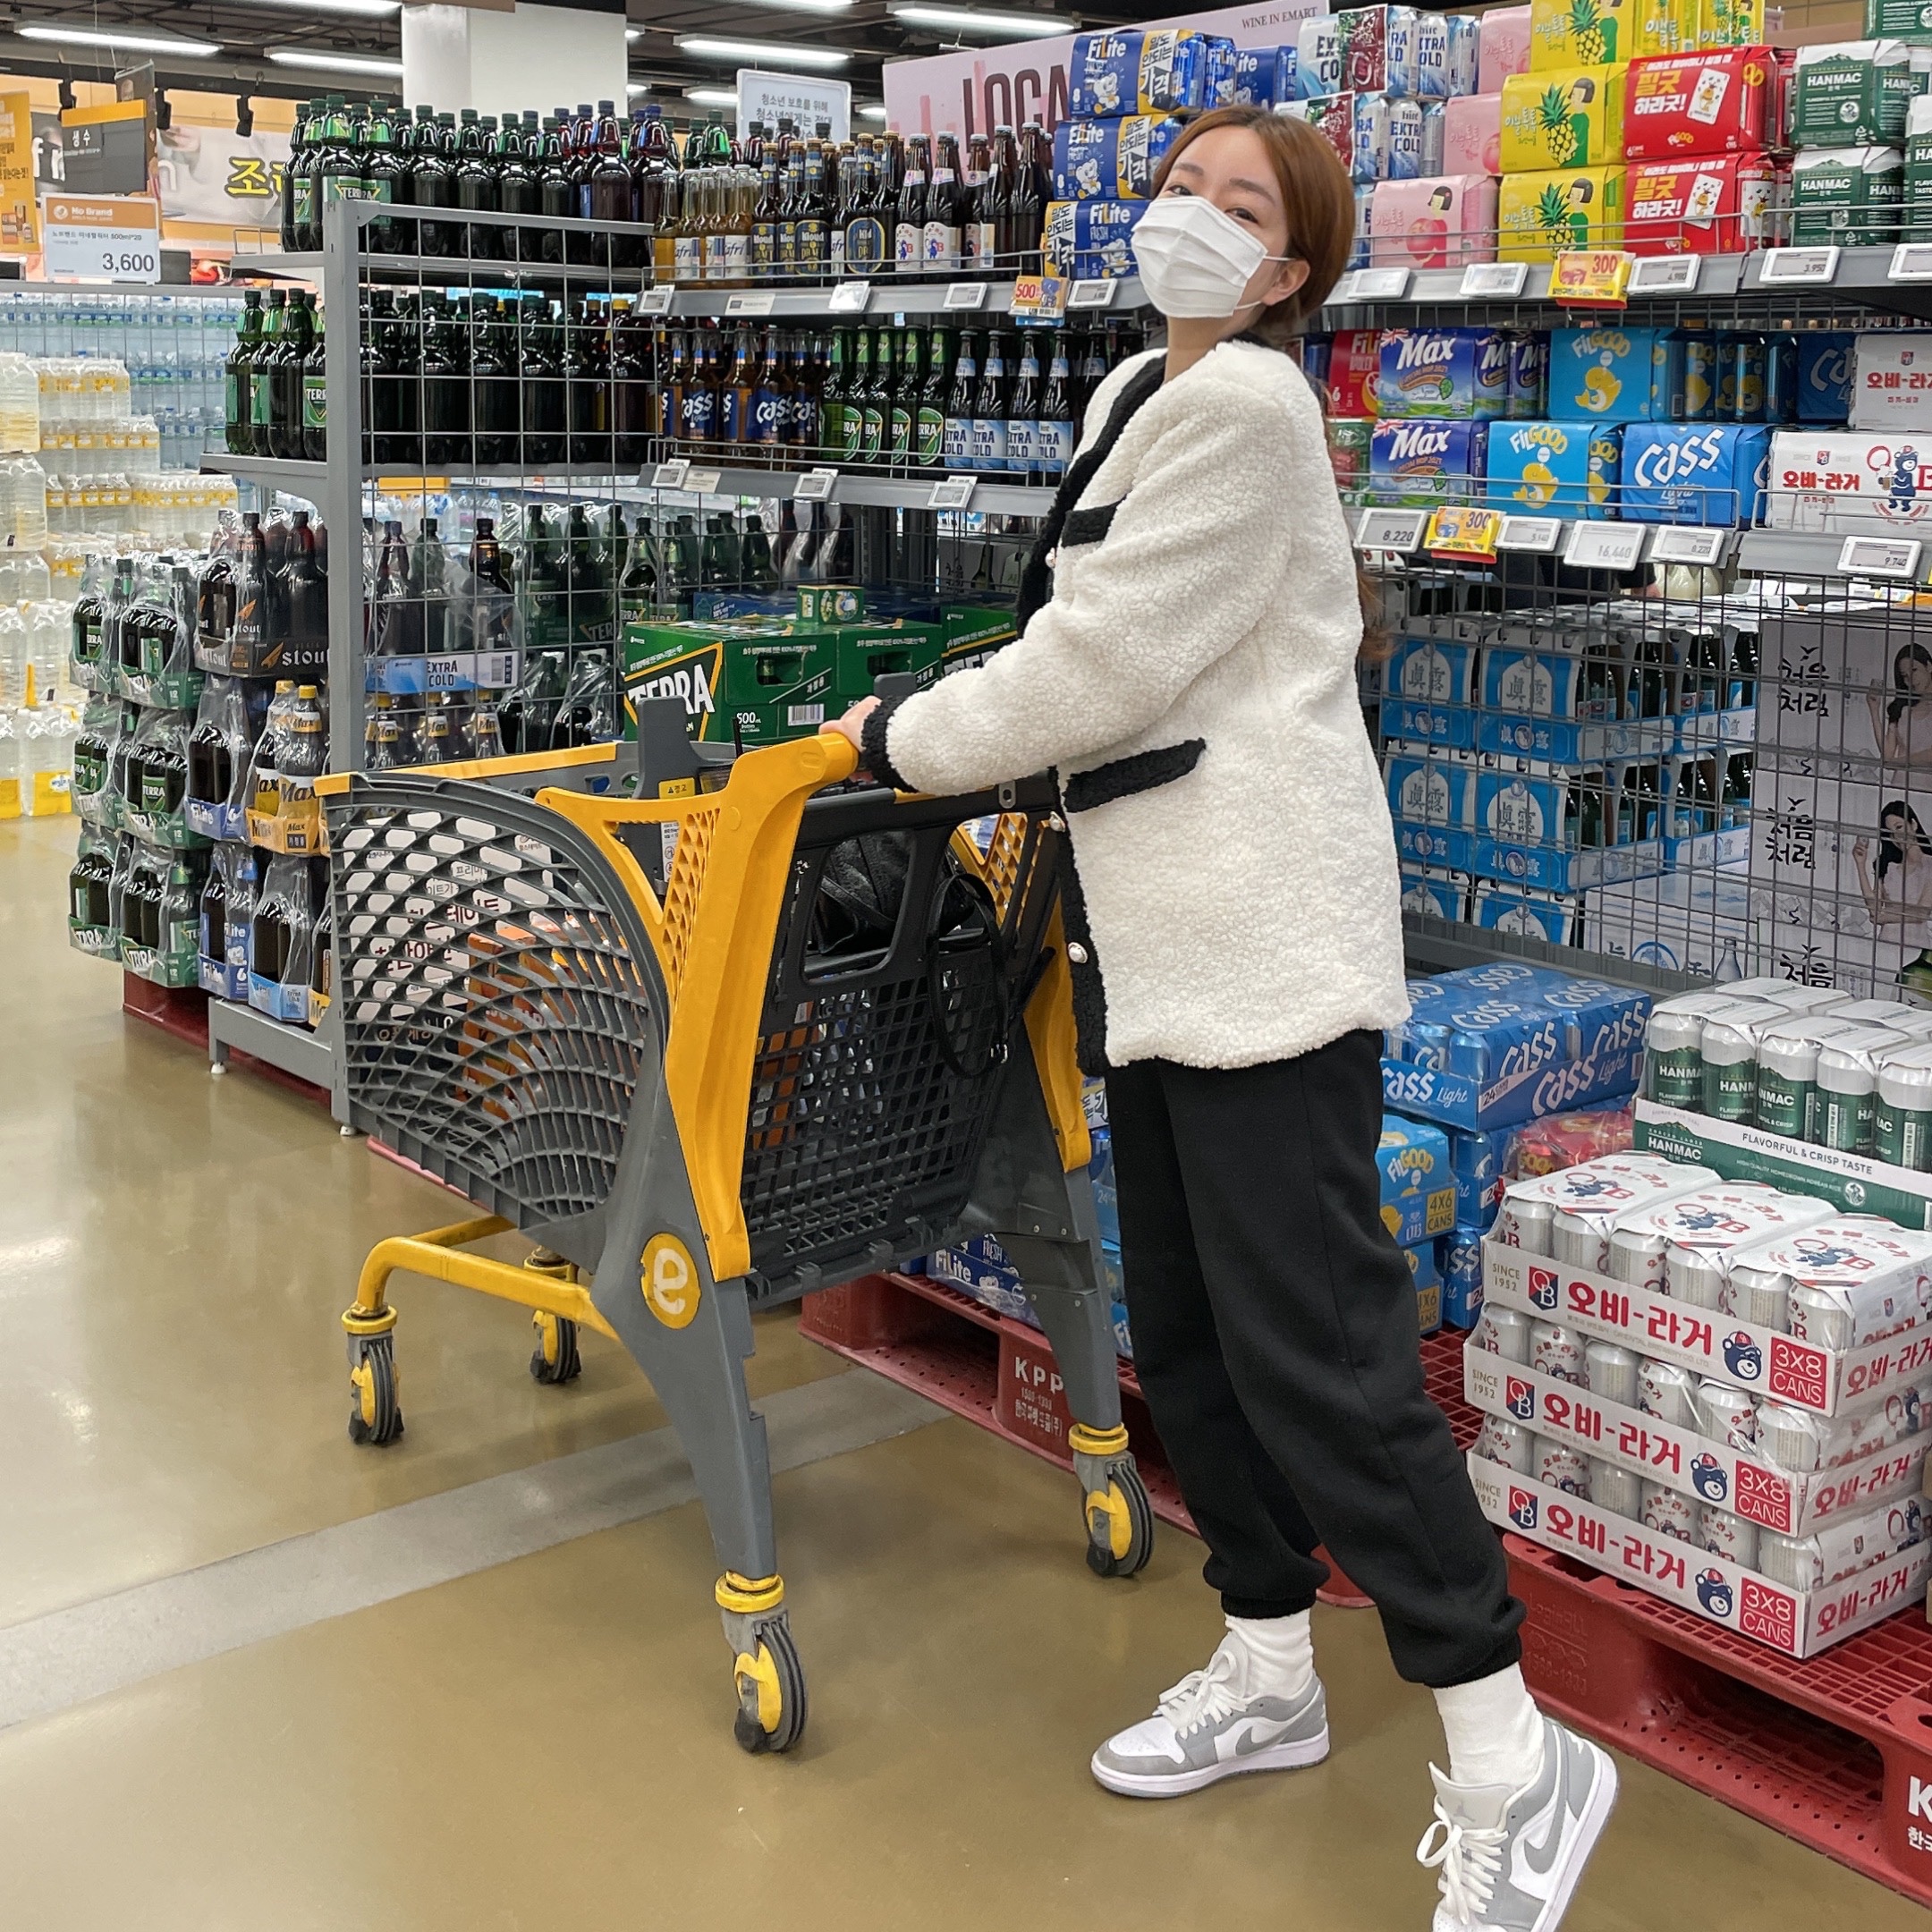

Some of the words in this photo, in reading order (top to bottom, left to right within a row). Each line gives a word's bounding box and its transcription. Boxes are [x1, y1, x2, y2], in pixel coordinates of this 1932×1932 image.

[1242, 15, 1267, 30] WINE
[1269, 13, 1280, 25] IN
[1282, 7, 1317, 22] EMART
[1088, 36, 1127, 59] FiLite
[1142, 47, 1173, 69] 안되는
[1140, 65, 1171, 106] 가격
[1634, 69, 1682, 97] 필굿
[1807, 72, 1862, 87] HANMAC
[761, 93, 785, 107] 청소년
[788, 97, 810, 111] 보호를
[812, 100, 828, 113] 위해
[1402, 109, 1419, 120] hite
[1633, 94, 1687, 115] 하라굿!
[1504, 106, 1537, 136] 이슬톡톡
[72, 129, 90, 147] 생수
[1119, 133, 1146, 153] 안되는
[1118, 151, 1147, 190] 가격
[1632, 174, 1678, 201] 필굿
[1801, 178, 1851, 191] HANMAC
[72, 207, 85, 216] No
[87, 208, 113, 218] Brand
[1089, 202, 1131, 225] FiLite
[1632, 199, 1682, 219] 하라굿!
[801, 231, 824, 242] Kloud
[102, 252, 155, 274] 3,600
[1593, 254, 1618, 274] 300
[1015, 283, 1036, 299] 500
[1396, 334, 1456, 370] Max
[1388, 424, 1452, 462] Max
[1508, 426, 1568, 454] FiLGOOD
[1633, 428, 1725, 488] Cass
[1783, 470, 1860, 492] 오비-라거
[1466, 511, 1491, 529] 300
[1383, 530, 1414, 542] 8.220
[1597, 544, 1631, 559] 16.440
[427, 660, 458, 673] EXTRA
[428, 674, 454, 688] COLD
[1778, 691, 1831, 717] 처럼
[143, 784, 165, 796] TERRA
[1764, 834, 1818, 870] 처럼
[236, 967, 247, 982] 6
[1436, 1085, 1469, 1108] Light
[1482, 1089, 1496, 1105] 24
[1531, 1055, 1597, 1116] Cass
[1648, 1136, 1702, 1160] HANMAC
[1742, 1132, 1799, 1157] FLAVORFUL
[1801, 1148, 1808, 1158] &
[1809, 1150, 1840, 1166] CRISP
[1842, 1157, 1873, 1175] TASTE
[1387, 1148, 1434, 1182] FiLGOOD
[1429, 1191, 1453, 1212] 4X6
[1427, 1213, 1453, 1232] CANS
[982, 1239, 1004, 1264] FRESH
[935, 1249, 972, 1283] FiLite
[1492, 1262, 1521, 1280] SINCE
[653, 1247, 687, 1316] e
[1494, 1277, 1518, 1292] 1952
[1531, 1270, 1555, 1307] OB
[1567, 1281, 1713, 1356] 오비-라거
[1775, 1344, 1822, 1378] 3X8
[1015, 1356, 1064, 1394] KPP
[1472, 1368, 1498, 1387] SINCE
[1473, 1383, 1496, 1399] 1952
[1509, 1378, 1532, 1418] OB
[1773, 1373, 1823, 1404] CANS
[1543, 1393, 1681, 1474] 오비-라거
[1475, 1479, 1502, 1496] SINCE
[1740, 1467, 1786, 1503] 3X8
[1812, 1453, 1911, 1519] 오비-라거
[1478, 1493, 1498, 1509] 1952
[1511, 1489, 1536, 1527] OB
[1738, 1495, 1787, 1528] CANS
[1546, 1504, 1685, 1589] 오비-라거
[1745, 1584, 1791, 1622] 3X8
[1816, 1566, 1909, 1638] 오비-라거
[1742, 1612, 1792, 1648] CANS
